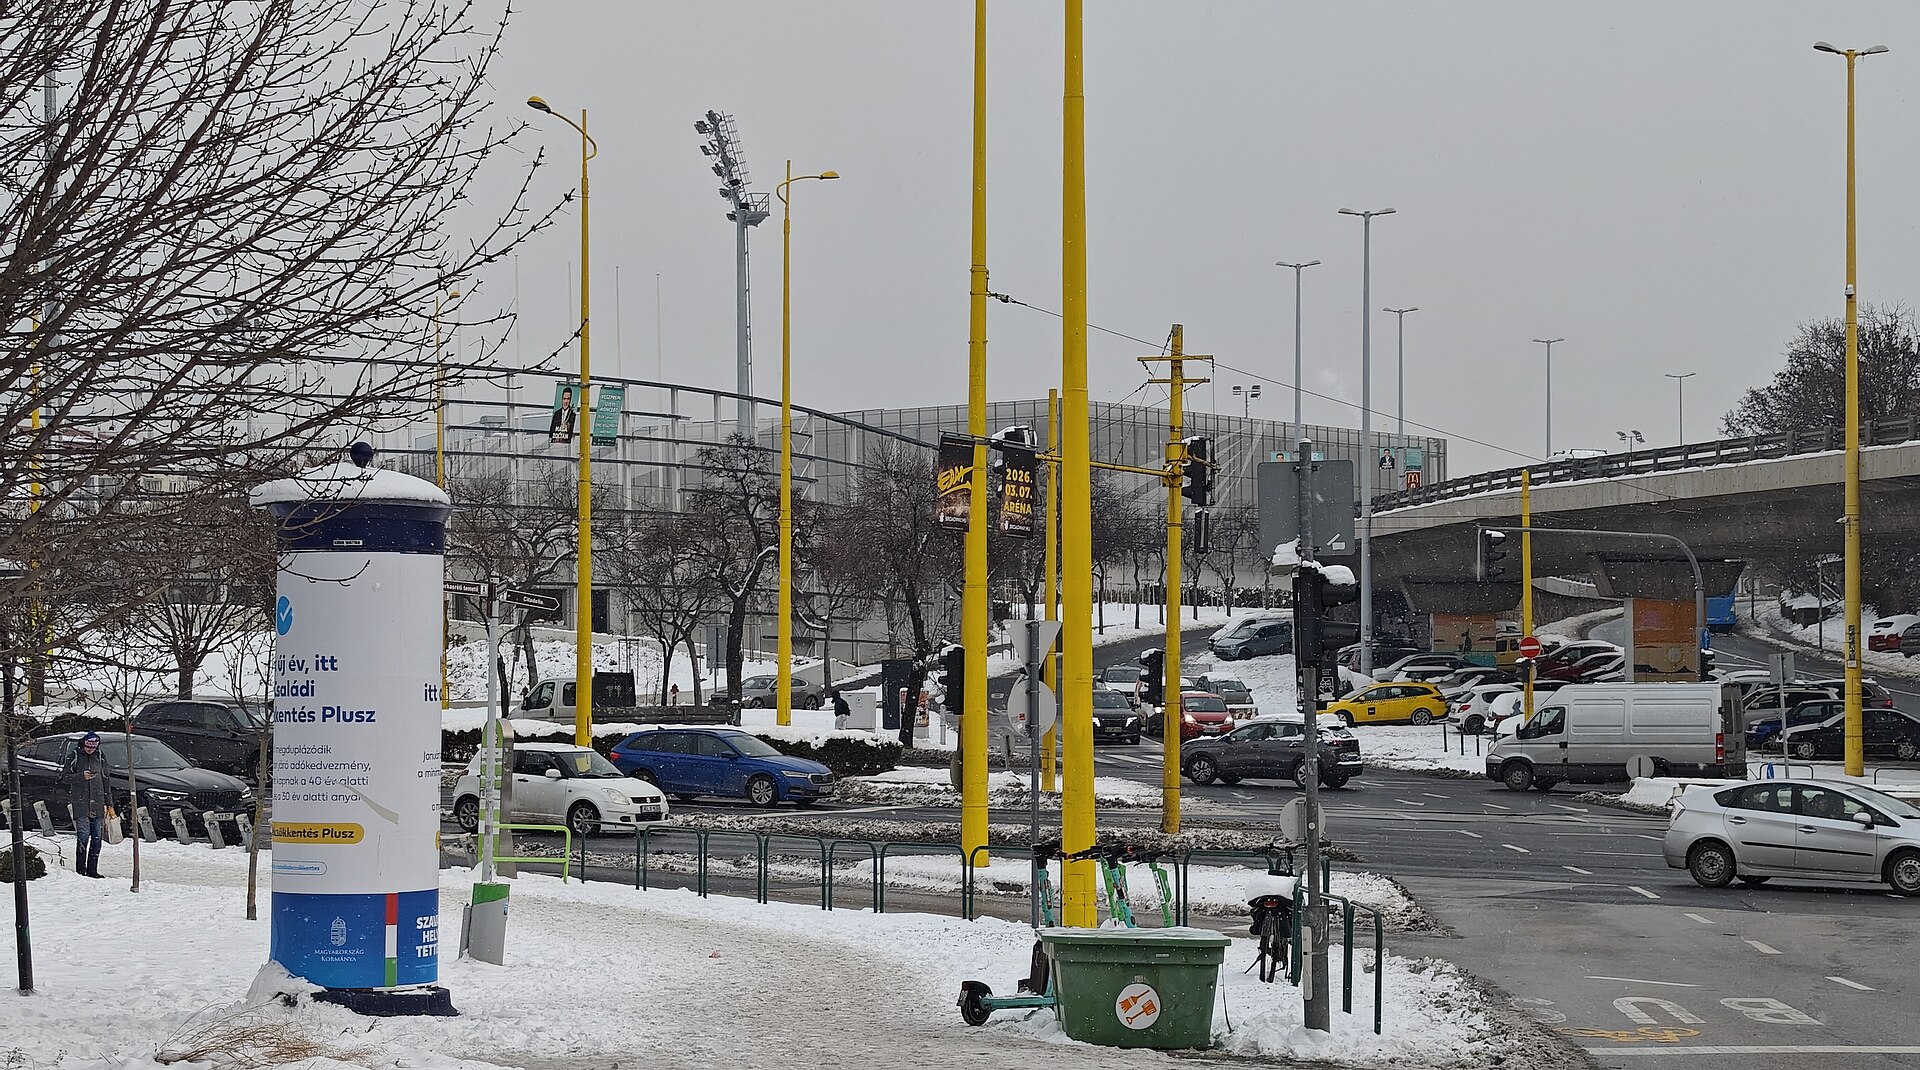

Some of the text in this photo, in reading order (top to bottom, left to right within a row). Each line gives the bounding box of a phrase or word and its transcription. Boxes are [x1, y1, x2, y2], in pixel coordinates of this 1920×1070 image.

[1005, 468, 1033, 484] 2026.
[1005, 485, 1033, 499] 03.07.
[1003, 500, 1033, 515] ARÉNA
[314, 653, 339, 672] itt
[424, 683, 438, 702] itt
[321, 705, 376, 723] Plusz
[290, 760, 372, 772] adókedvezmény,
[309, 776, 322, 786] 40
[339, 776, 369, 787] alatti
[302, 792, 329, 802] alatti
[322, 828, 355, 839] Plusz
[314, 947, 365, 955] MAGYARORSZÁG
